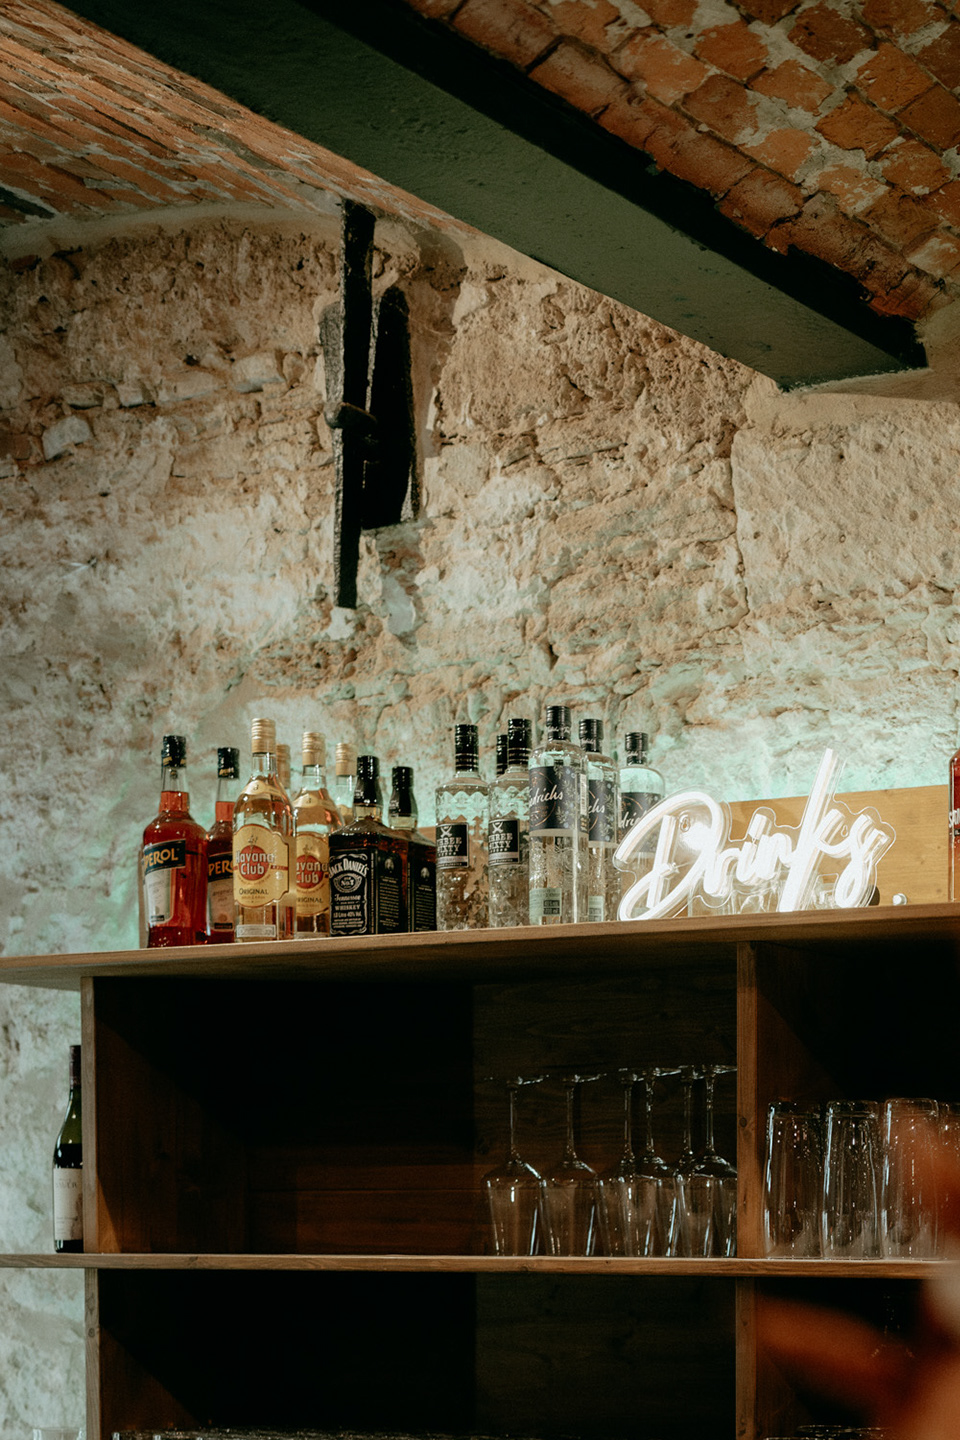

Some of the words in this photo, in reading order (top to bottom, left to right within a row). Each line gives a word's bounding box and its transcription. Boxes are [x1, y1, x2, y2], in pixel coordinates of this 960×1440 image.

[615, 747, 890, 921] Drinks
[235, 850, 276, 864] Havana
[240, 862, 265, 875] Club
